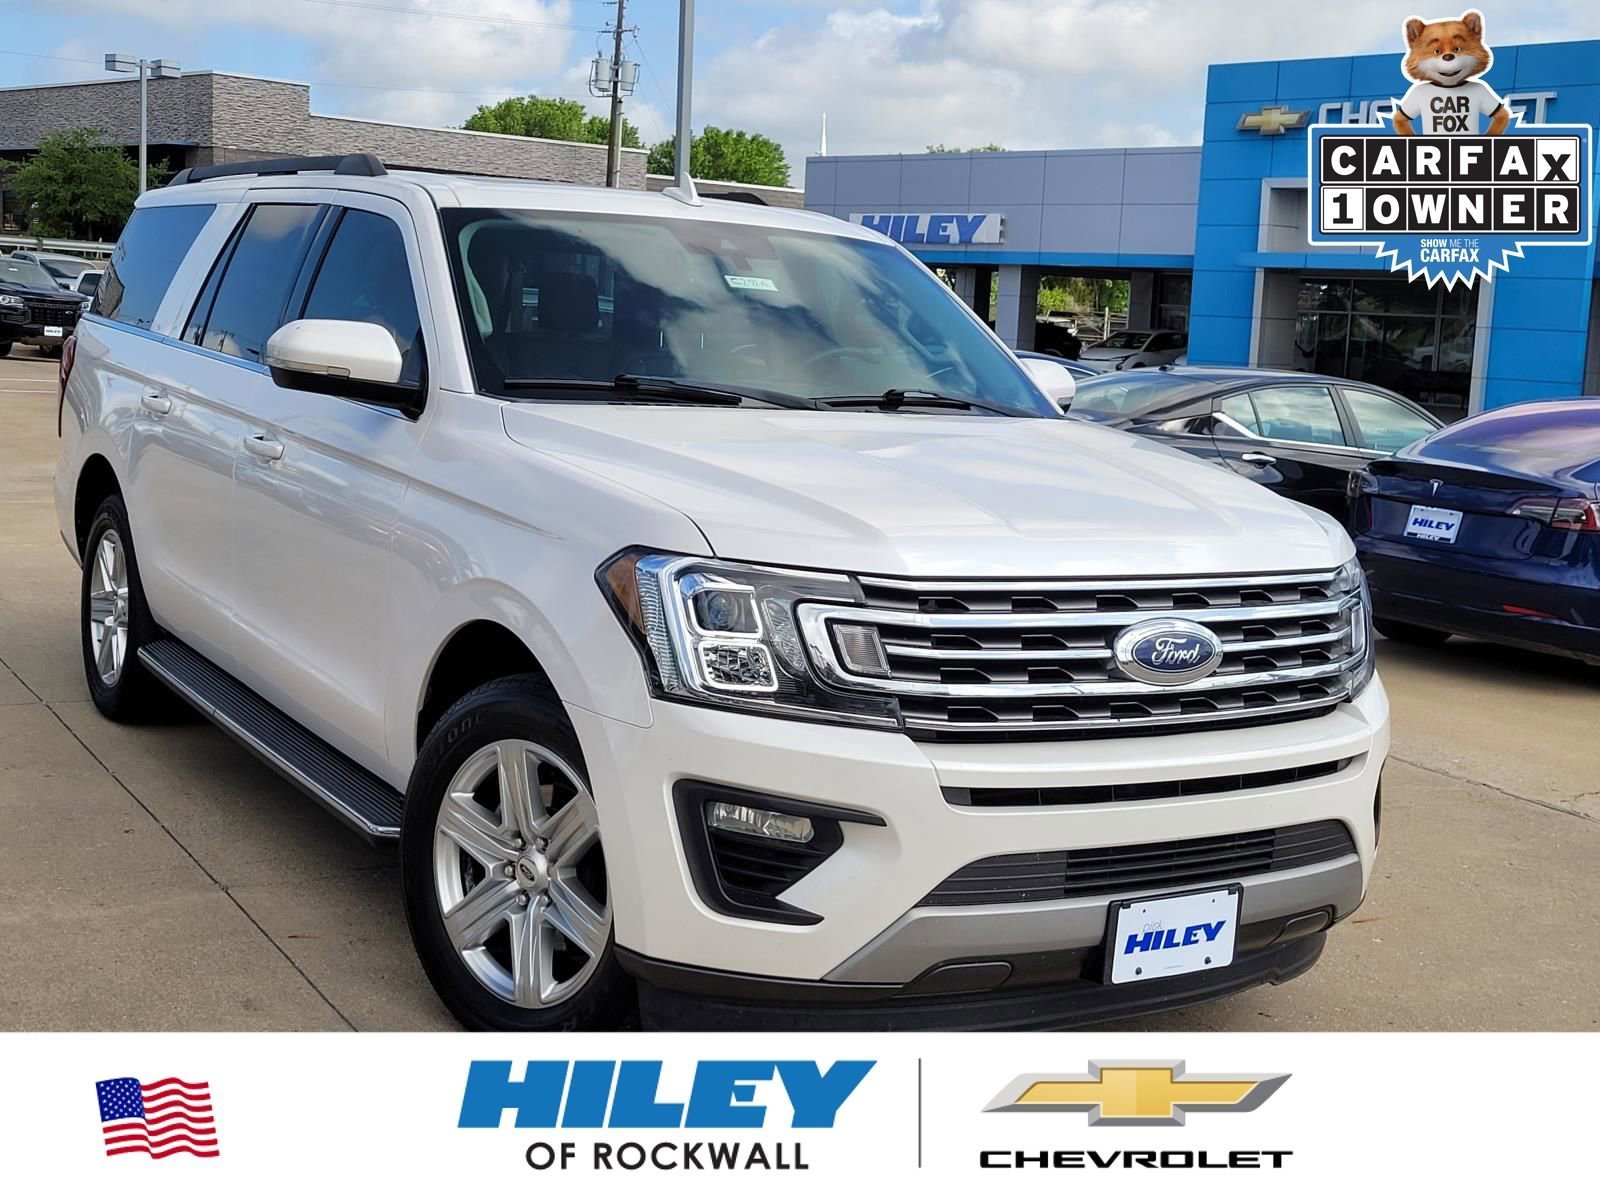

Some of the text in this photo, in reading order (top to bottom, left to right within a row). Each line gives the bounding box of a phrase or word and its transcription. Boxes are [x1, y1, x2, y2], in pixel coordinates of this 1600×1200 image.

[1412, 518, 1455, 531] HILEY
[1151, 637, 1200, 665] Ford
[1124, 920, 1227, 955] HILEY
